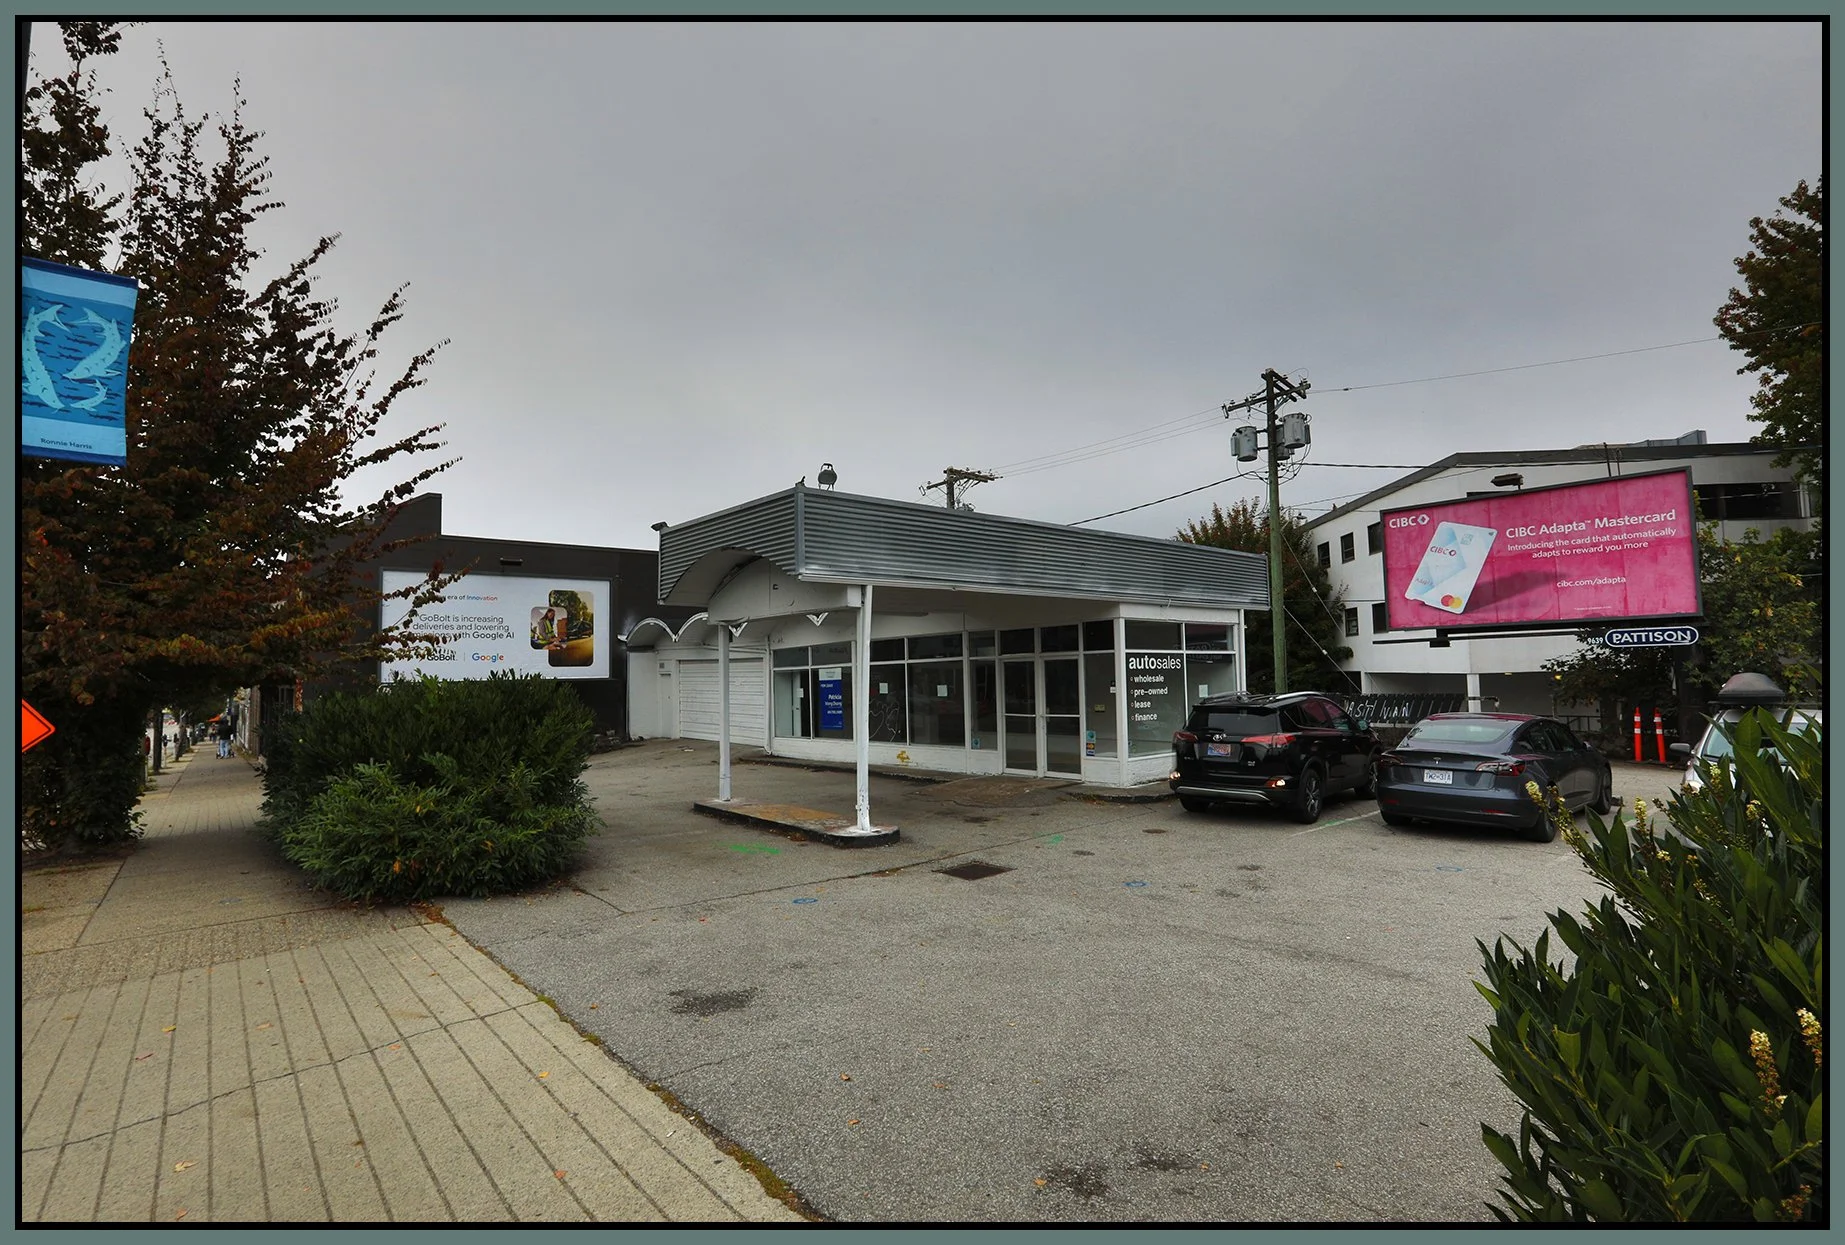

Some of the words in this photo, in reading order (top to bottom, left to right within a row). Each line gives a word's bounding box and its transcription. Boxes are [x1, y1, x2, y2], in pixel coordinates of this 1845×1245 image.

[40, 437, 68, 447] Ronnie
[69, 441, 93, 450] Harris
[1389, 515, 1417, 529] CIBC
[1506, 525, 1537, 539] CIBC
[1594, 508, 1676, 529] Mastercard
[1507, 541, 1554, 552] Introducing
[1555, 539, 1570, 547] the
[1571, 535, 1591, 545] card
[1592, 534, 1611, 543] that
[1612, 527, 1677, 542] automatically
[1430, 545, 1449, 556] CIBC
[1532, 548, 1561, 559] adapts
[1562, 547, 1571, 556] to
[1572, 543, 1604, 555] reward
[1605, 544, 1622, 553] you
[1624, 541, 1649, 550] more
[1556, 576, 1627, 589] cibc.com/adapta
[420, 614, 450, 622] GoBolt
[461, 615, 504, 625] increasing
[412, 623, 455, 631] deliveries
[474, 624, 510, 633] lowering
[472, 632, 504, 640] Google
[1587, 636, 1604, 645] 9639
[1612, 630, 1691, 644] PATTISON
[472, 652, 505, 663] Google
[1129, 655, 1182, 670] autosales
[1134, 675, 1165, 683] wholesale
[1134, 687, 1169, 698] pre-owned
[1134, 700, 1151, 708] lease
[1135, 713, 1158, 721] finance
